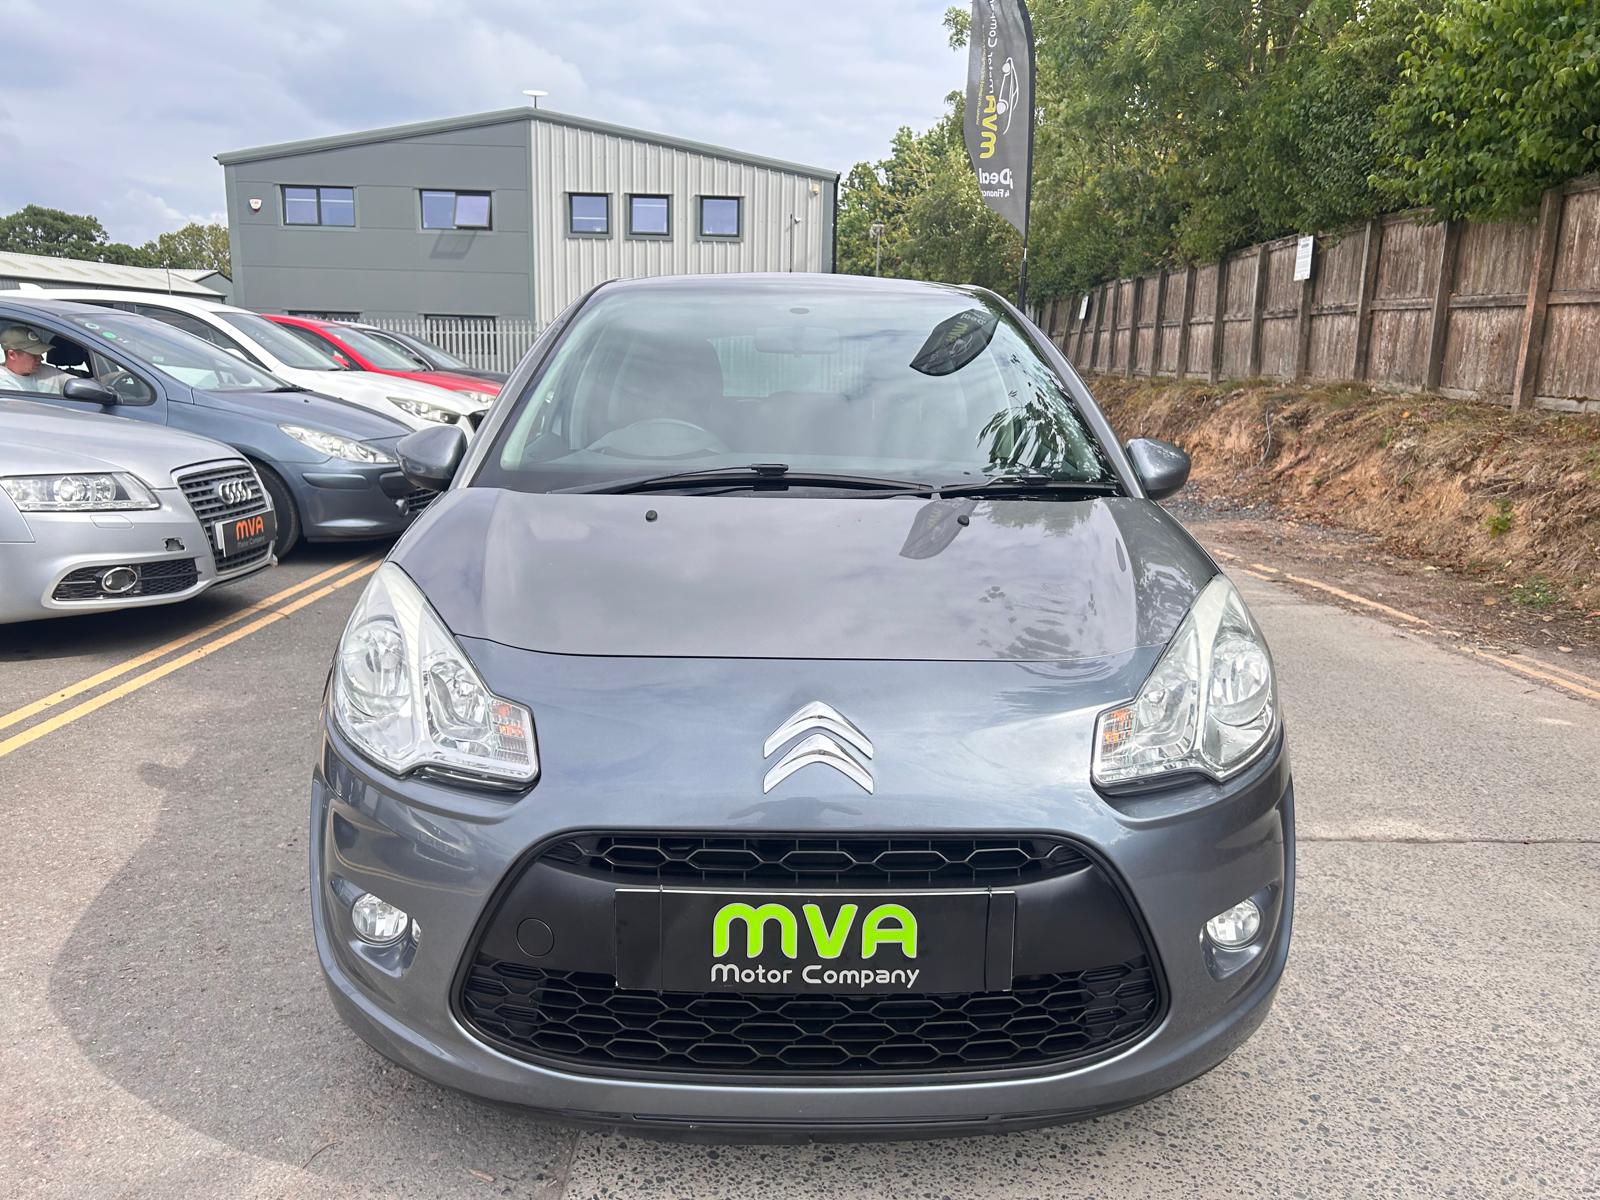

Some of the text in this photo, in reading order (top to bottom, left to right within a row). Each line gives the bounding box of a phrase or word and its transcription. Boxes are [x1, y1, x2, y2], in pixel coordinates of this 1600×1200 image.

[236, 516, 264, 541] MVA
[713, 902, 918, 959] MVA
[711, 963, 920, 988] Motor Company
